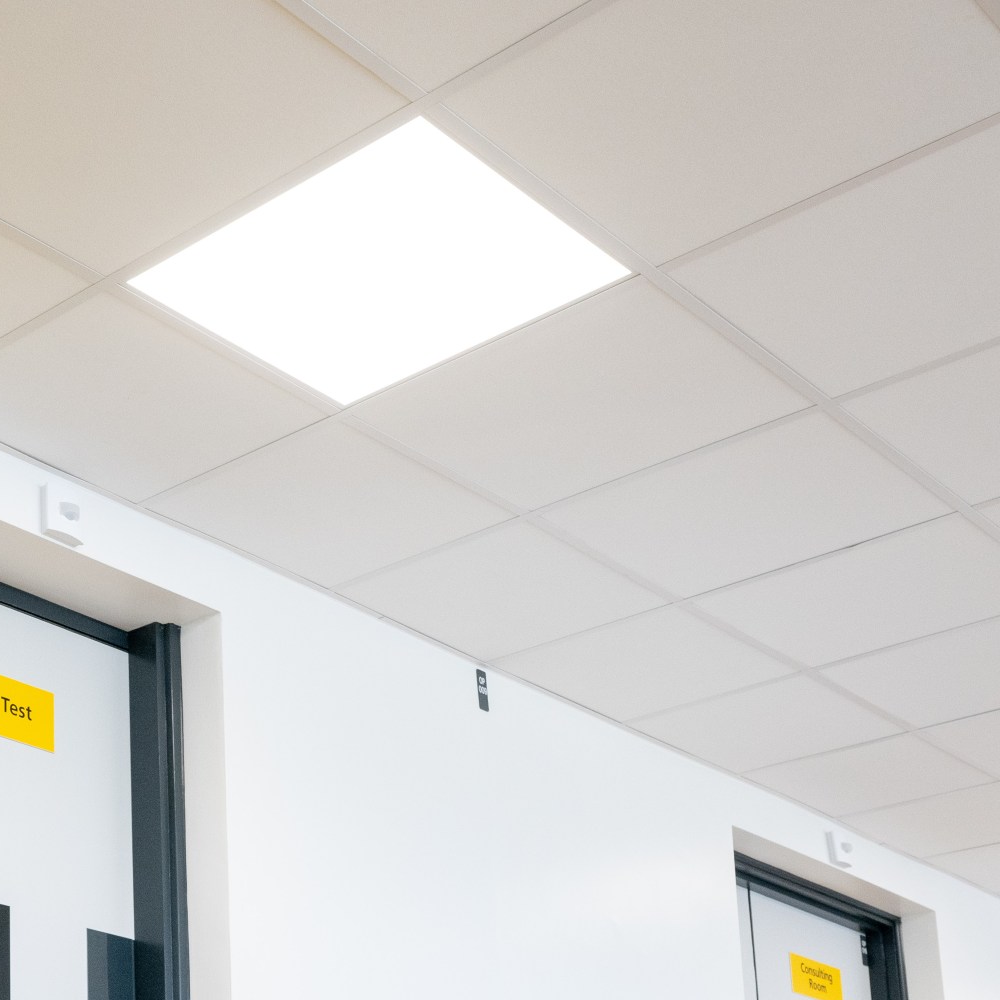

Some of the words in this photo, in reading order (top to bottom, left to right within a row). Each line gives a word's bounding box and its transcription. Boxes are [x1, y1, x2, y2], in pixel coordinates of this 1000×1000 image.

[1, 696, 32, 721] Test
[800, 962, 833, 985] Consulting
[808, 978, 827, 993] Room
